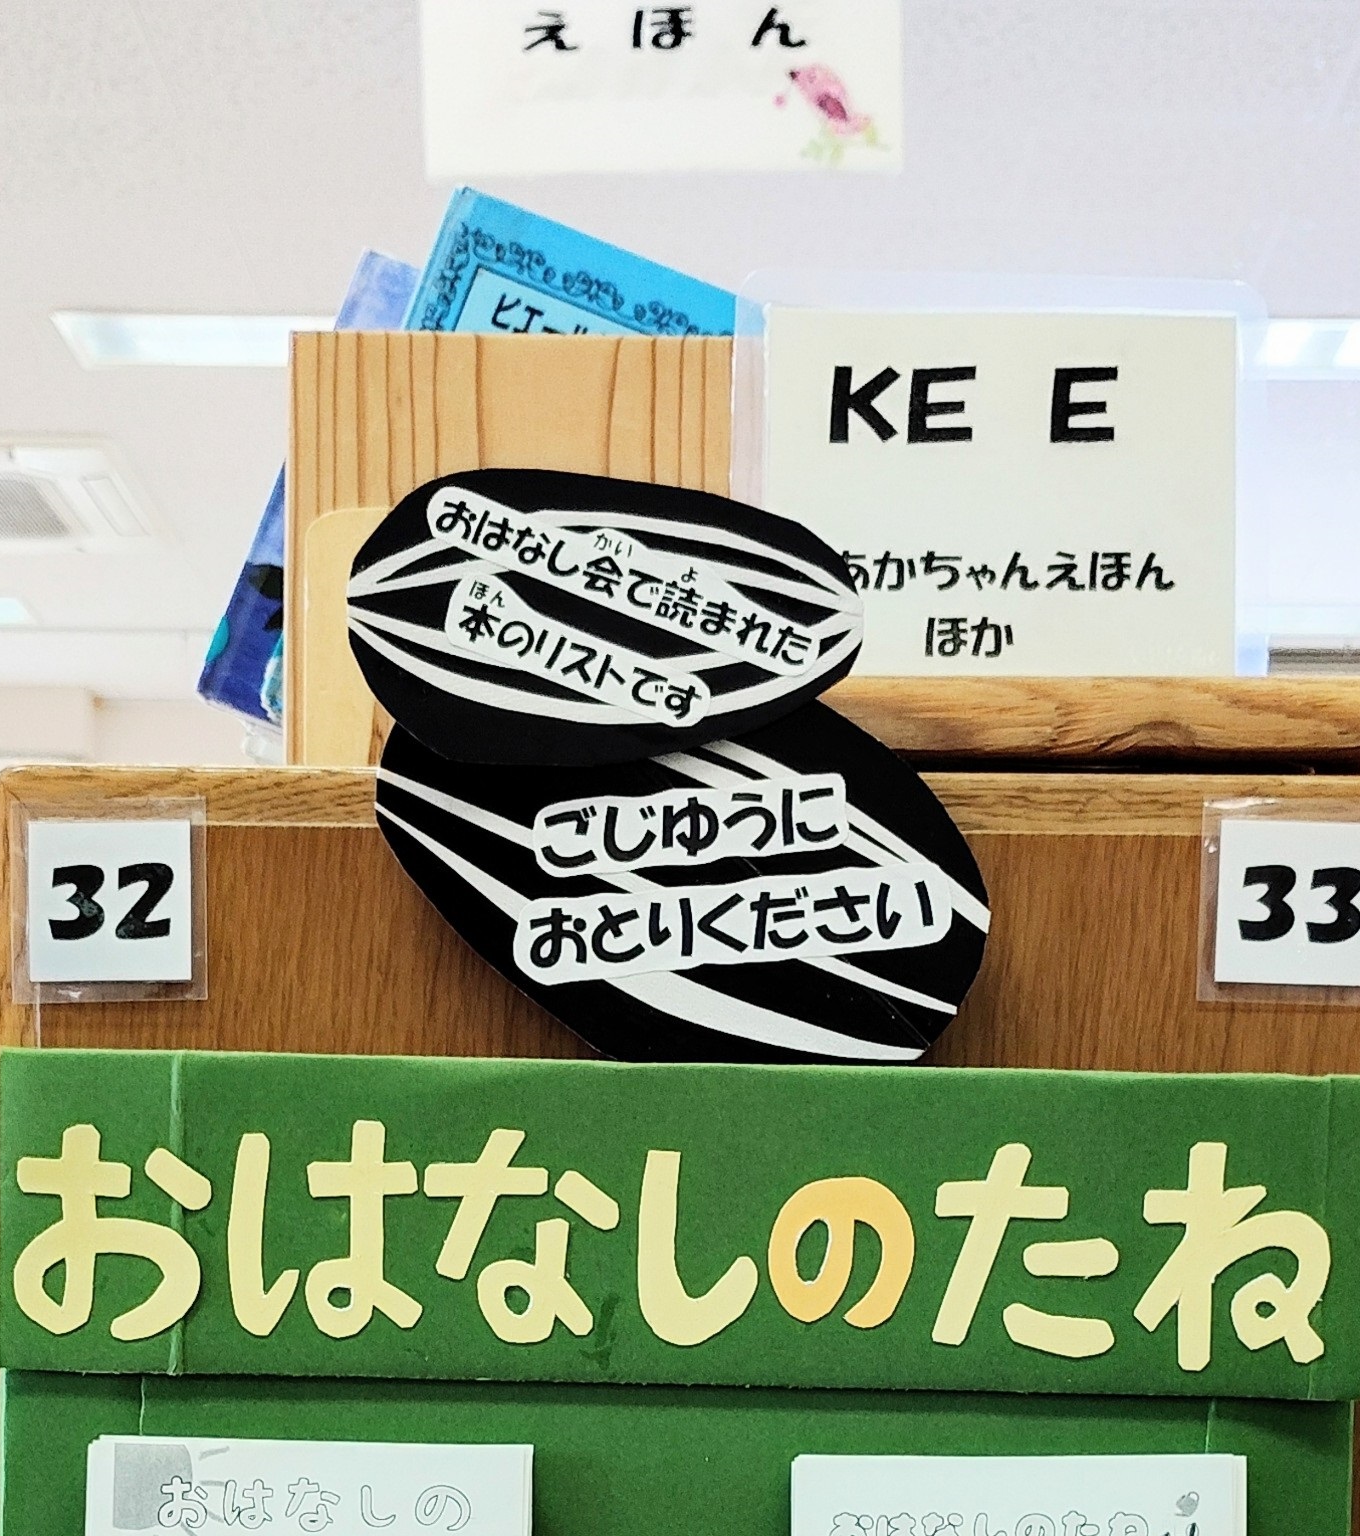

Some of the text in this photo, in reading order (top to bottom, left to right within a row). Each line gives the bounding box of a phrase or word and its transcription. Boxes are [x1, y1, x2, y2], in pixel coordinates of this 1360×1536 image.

[828, 365, 1120, 445] KE E
[436, 498, 814, 667] おはなし会で読まれた
[593, 532, 634, 559] かい
[468, 579, 507, 610] ほん
[459, 602, 702, 723] 本のリストです
[924, 615, 1016, 659] ほか
[541, 786, 842, 870] ごじゆうに
[46, 861, 176, 943] 32
[529, 877, 935, 969] おとりください
[11, 1118, 1334, 1376] おはなしのたね
[157, 1475, 473, 1532] おはなしの
